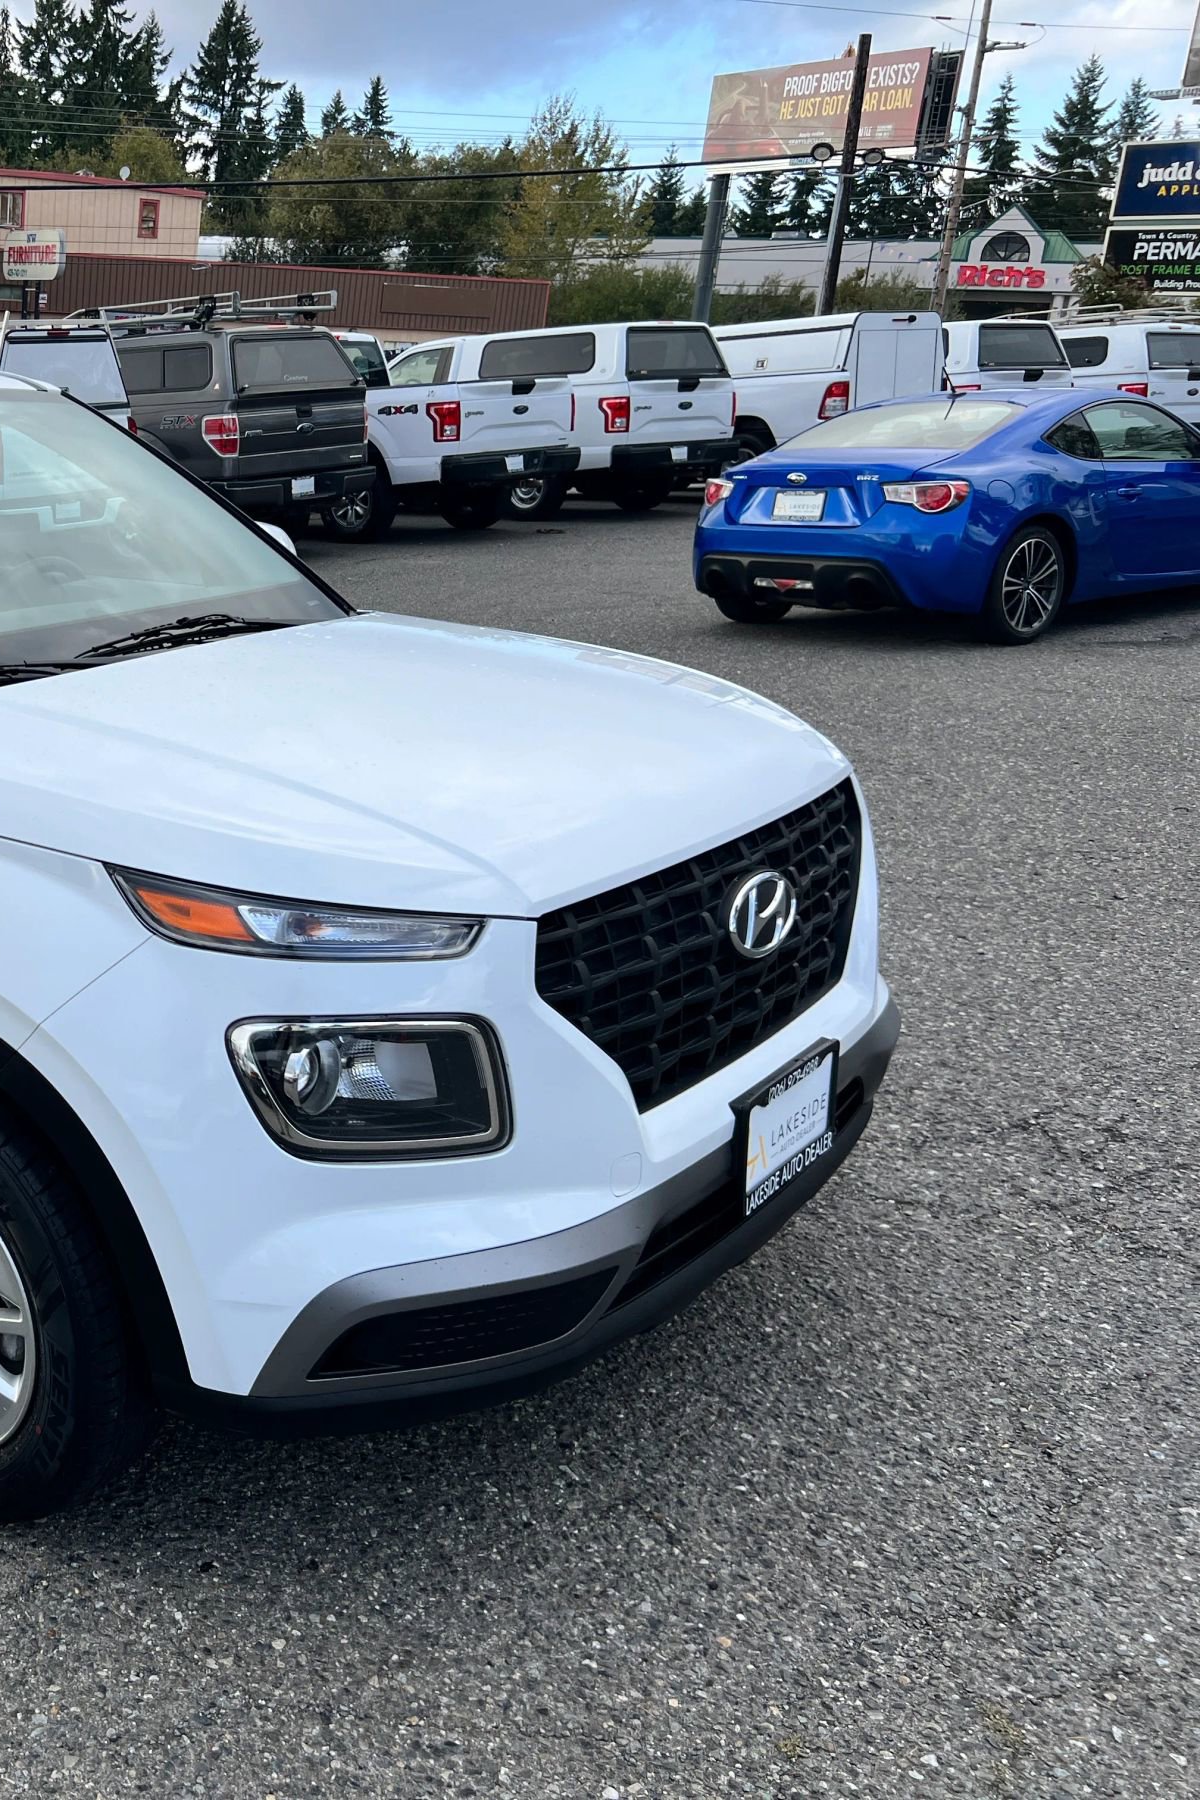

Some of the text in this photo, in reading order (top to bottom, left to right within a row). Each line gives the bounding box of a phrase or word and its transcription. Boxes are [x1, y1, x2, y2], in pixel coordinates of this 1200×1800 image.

[783, 62, 920, 97] PROOF BIGFO EXISTS?
[779, 100, 795, 120] HE
[795, 97, 822, 118] JUST
[822, 94, 846, 116] GOT
[861, 91, 878, 112] AR
[880, 88, 913, 110] LOAN.
[1137, 160, 1194, 188] judd
[1157, 184, 1200, 197] APPL
[1138, 232, 1198, 241] Town & Country,
[8, 244, 57, 266] FURNITURE
[1133, 241, 1200, 261] PERMA
[957, 264, 1046, 289] Rich's
[1120, 264, 1149, 276] POST
[1152, 264, 1190, 276] FRAME
[1153, 279, 1184, 291] Building
[161, 414, 199, 427] STX
[771, 1092, 827, 1147] LAKESIDE
[780, 1120, 816, 1152] AUTO DEALER
[745, 1131, 833, 1216] LAKESIDE AUTO DEALER
